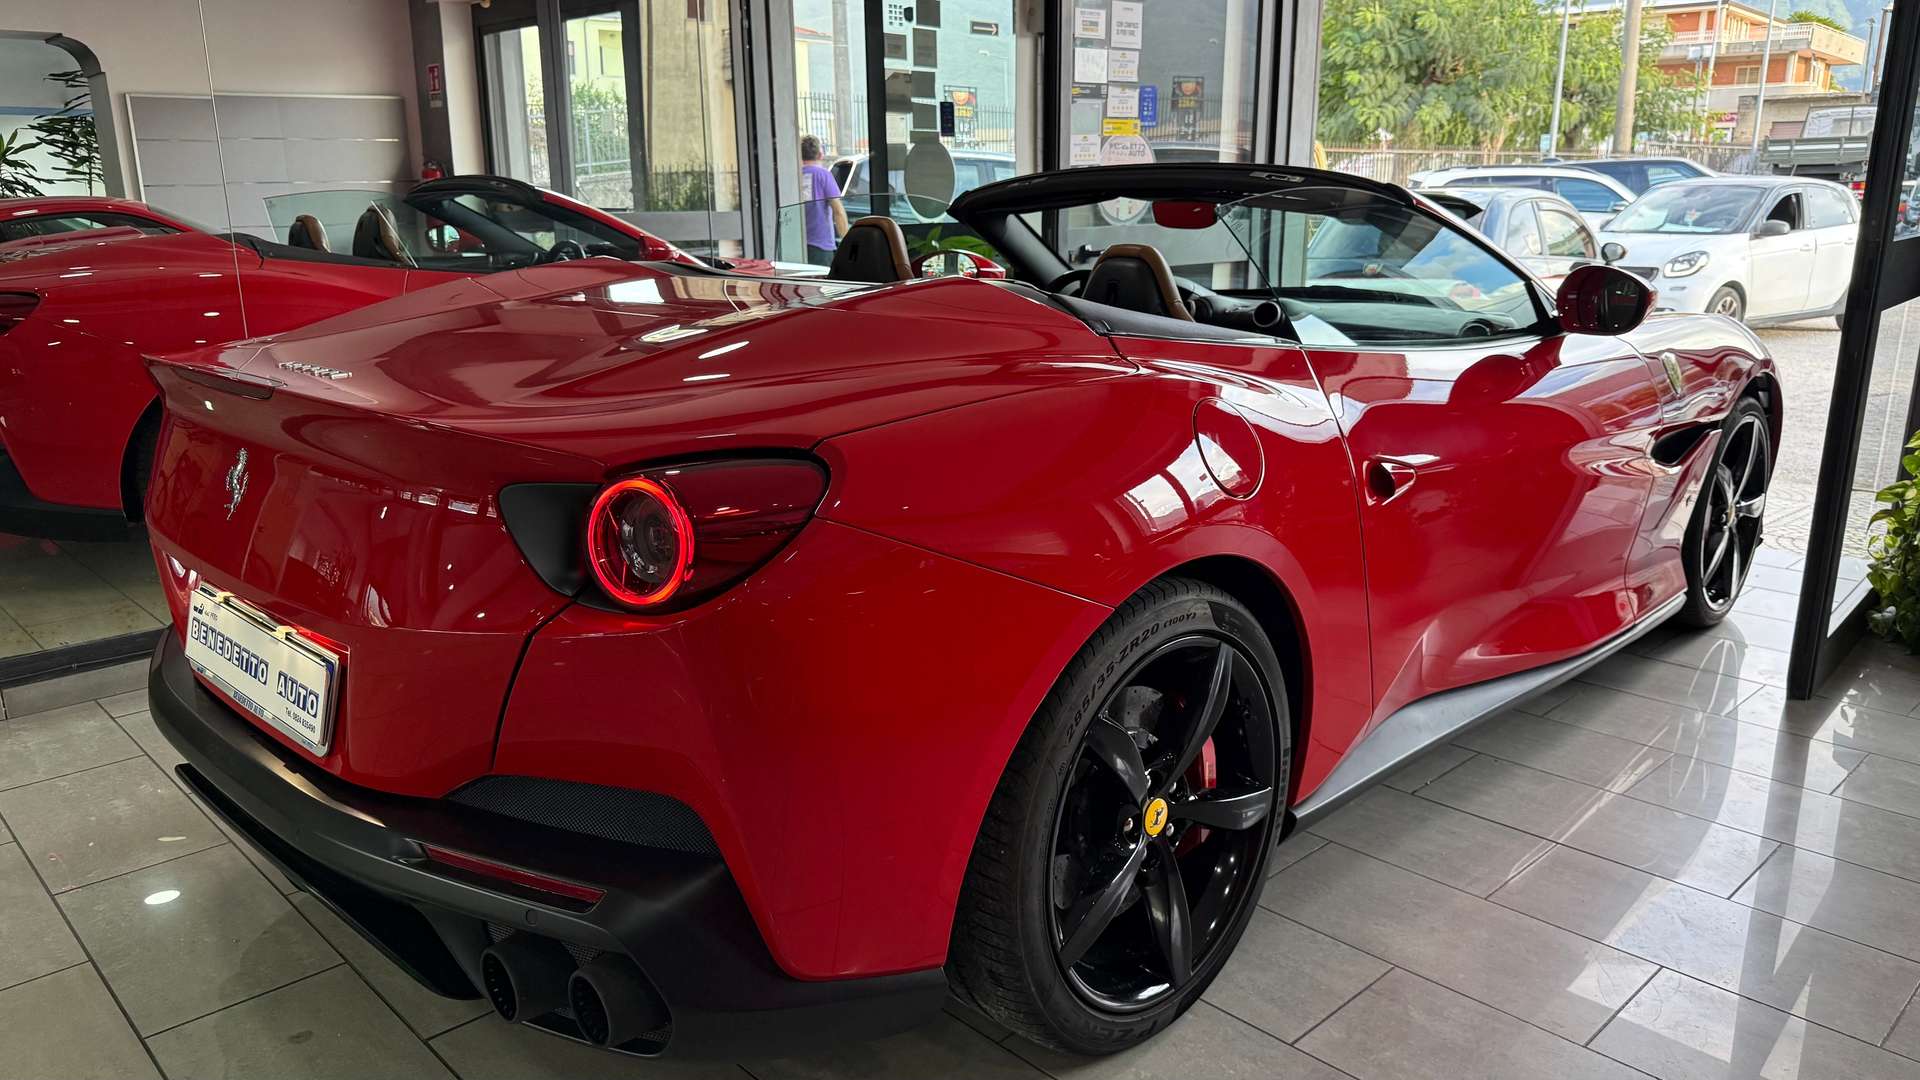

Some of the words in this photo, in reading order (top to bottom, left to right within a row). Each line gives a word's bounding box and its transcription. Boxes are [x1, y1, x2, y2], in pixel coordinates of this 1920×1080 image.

[191, 617, 268, 685] BENEDETTO
[277, 671, 319, 718] AUTO
[1066, 660, 1116, 743] 285/35
[1119, 623, 1160, 658] ZR20
[1163, 611, 1197, 629] (100Y)
